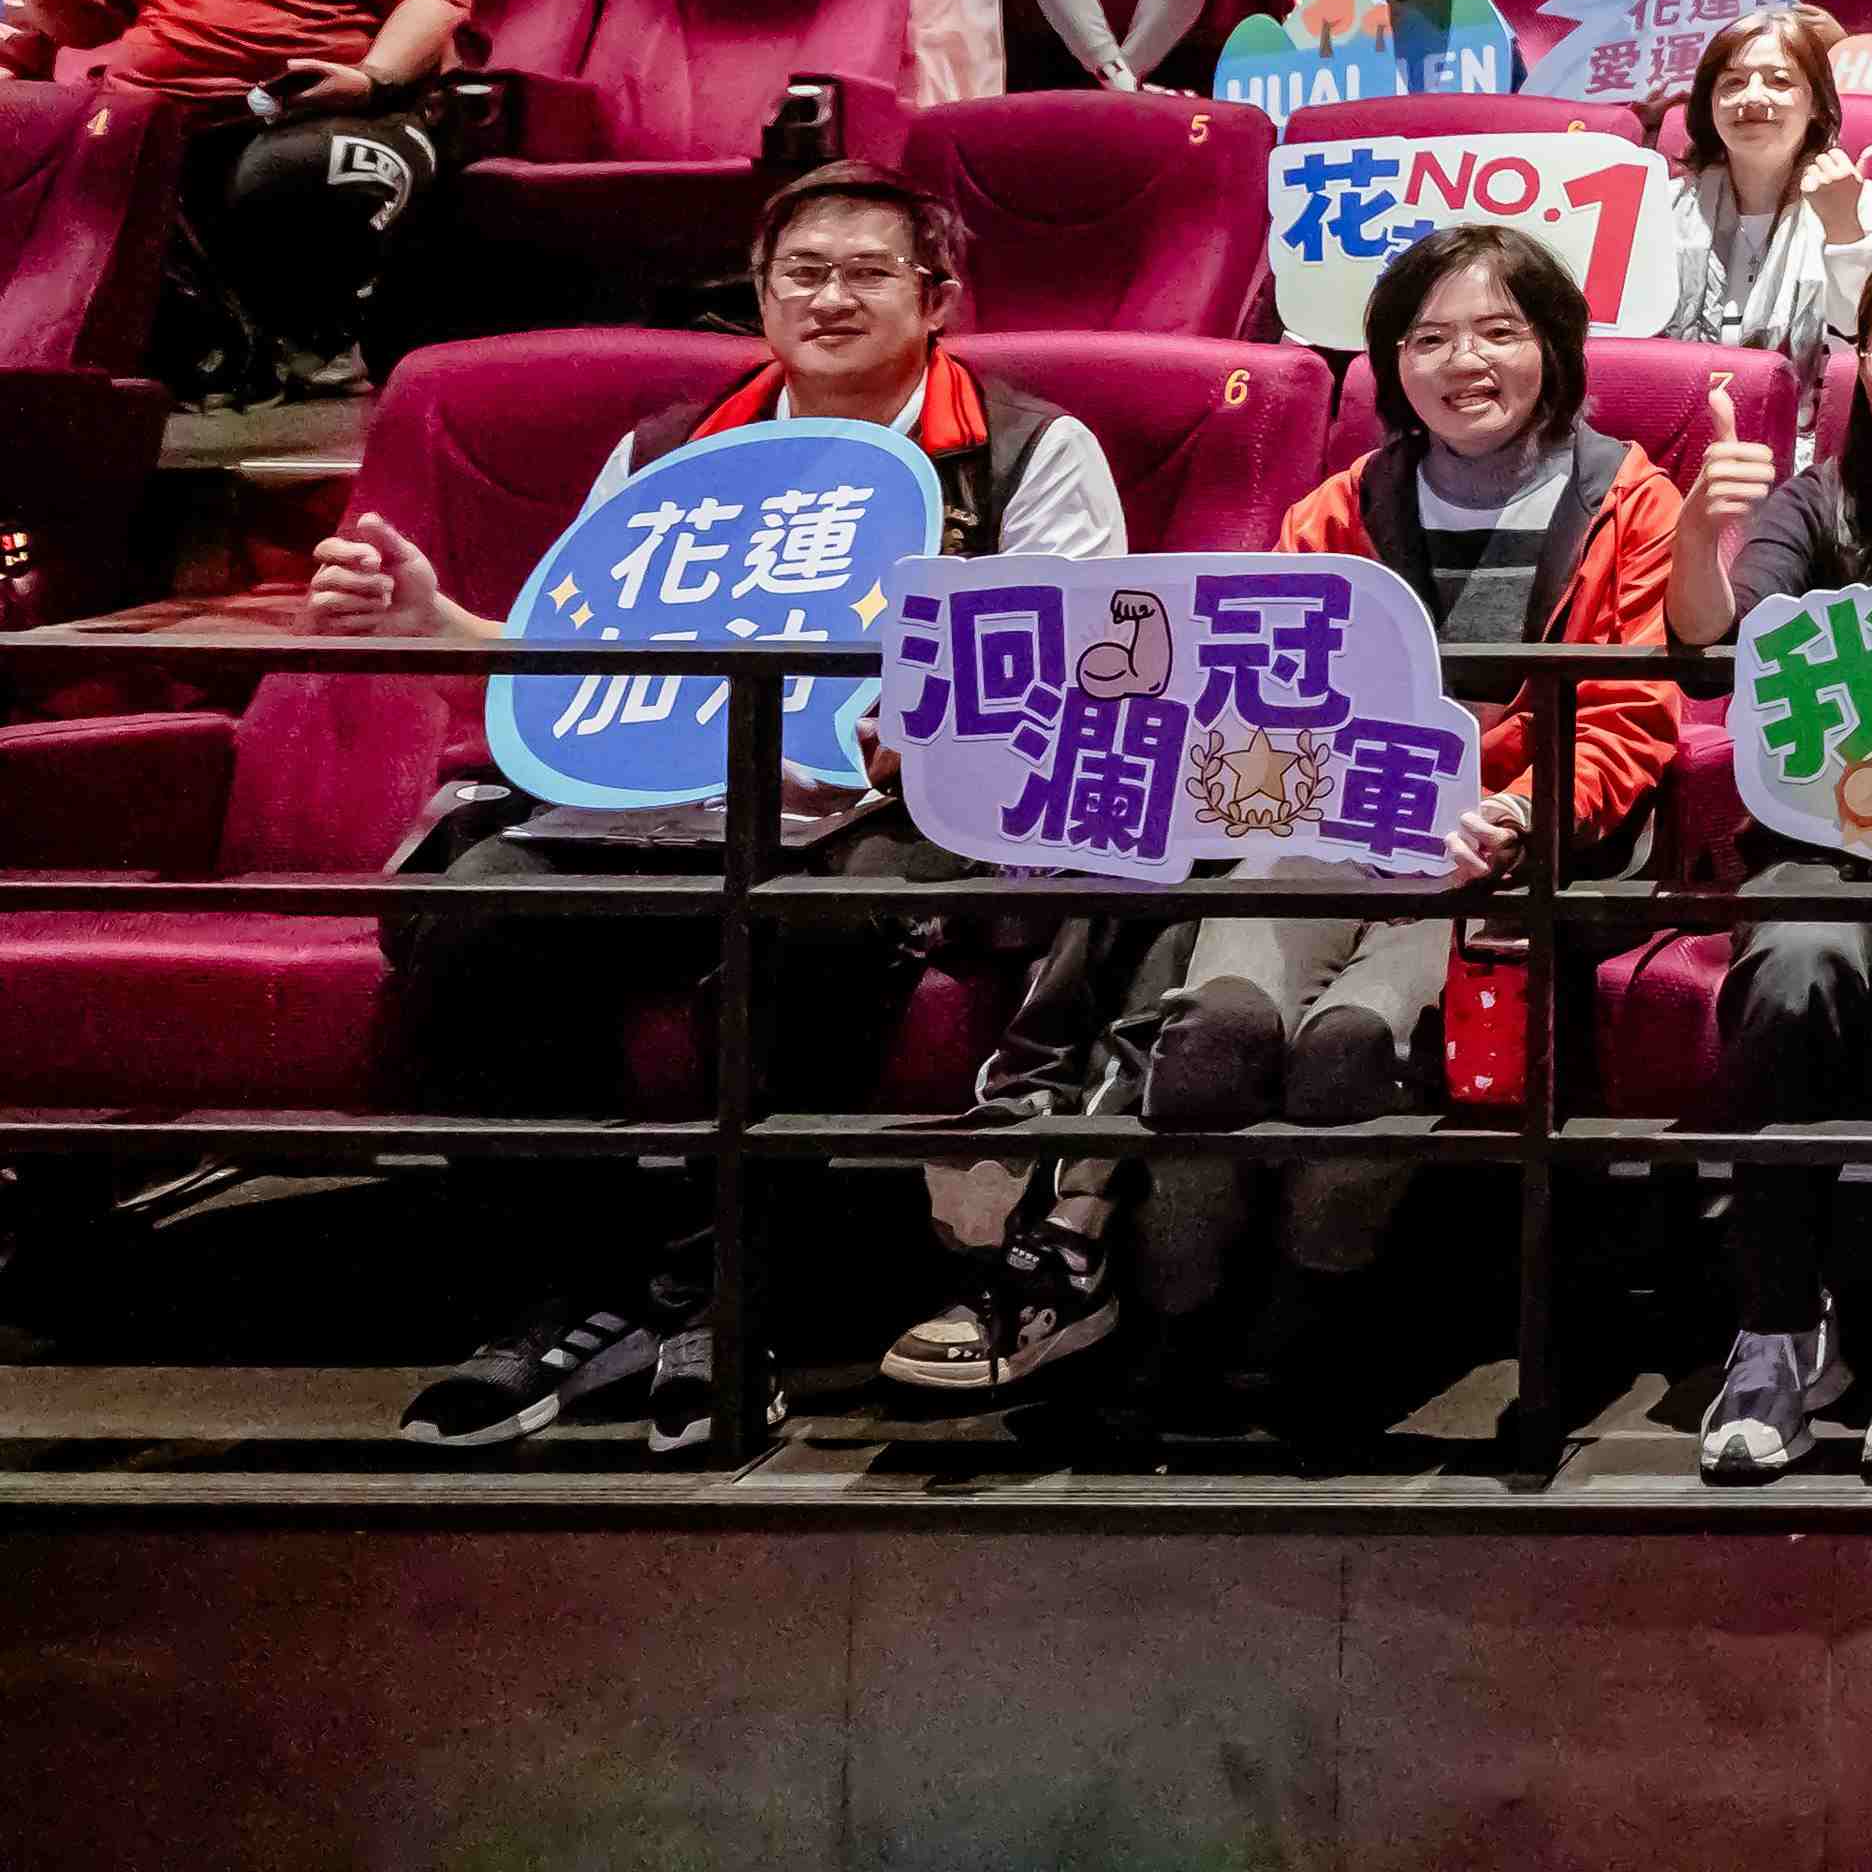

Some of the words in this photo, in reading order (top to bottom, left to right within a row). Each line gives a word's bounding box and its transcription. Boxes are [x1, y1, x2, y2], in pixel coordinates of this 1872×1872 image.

[1187, 115, 1211, 144] 5
[1404, 151, 1650, 326] NO.1
[1223, 368, 1250, 407] 6
[610, 485, 875, 609] 花蓮
